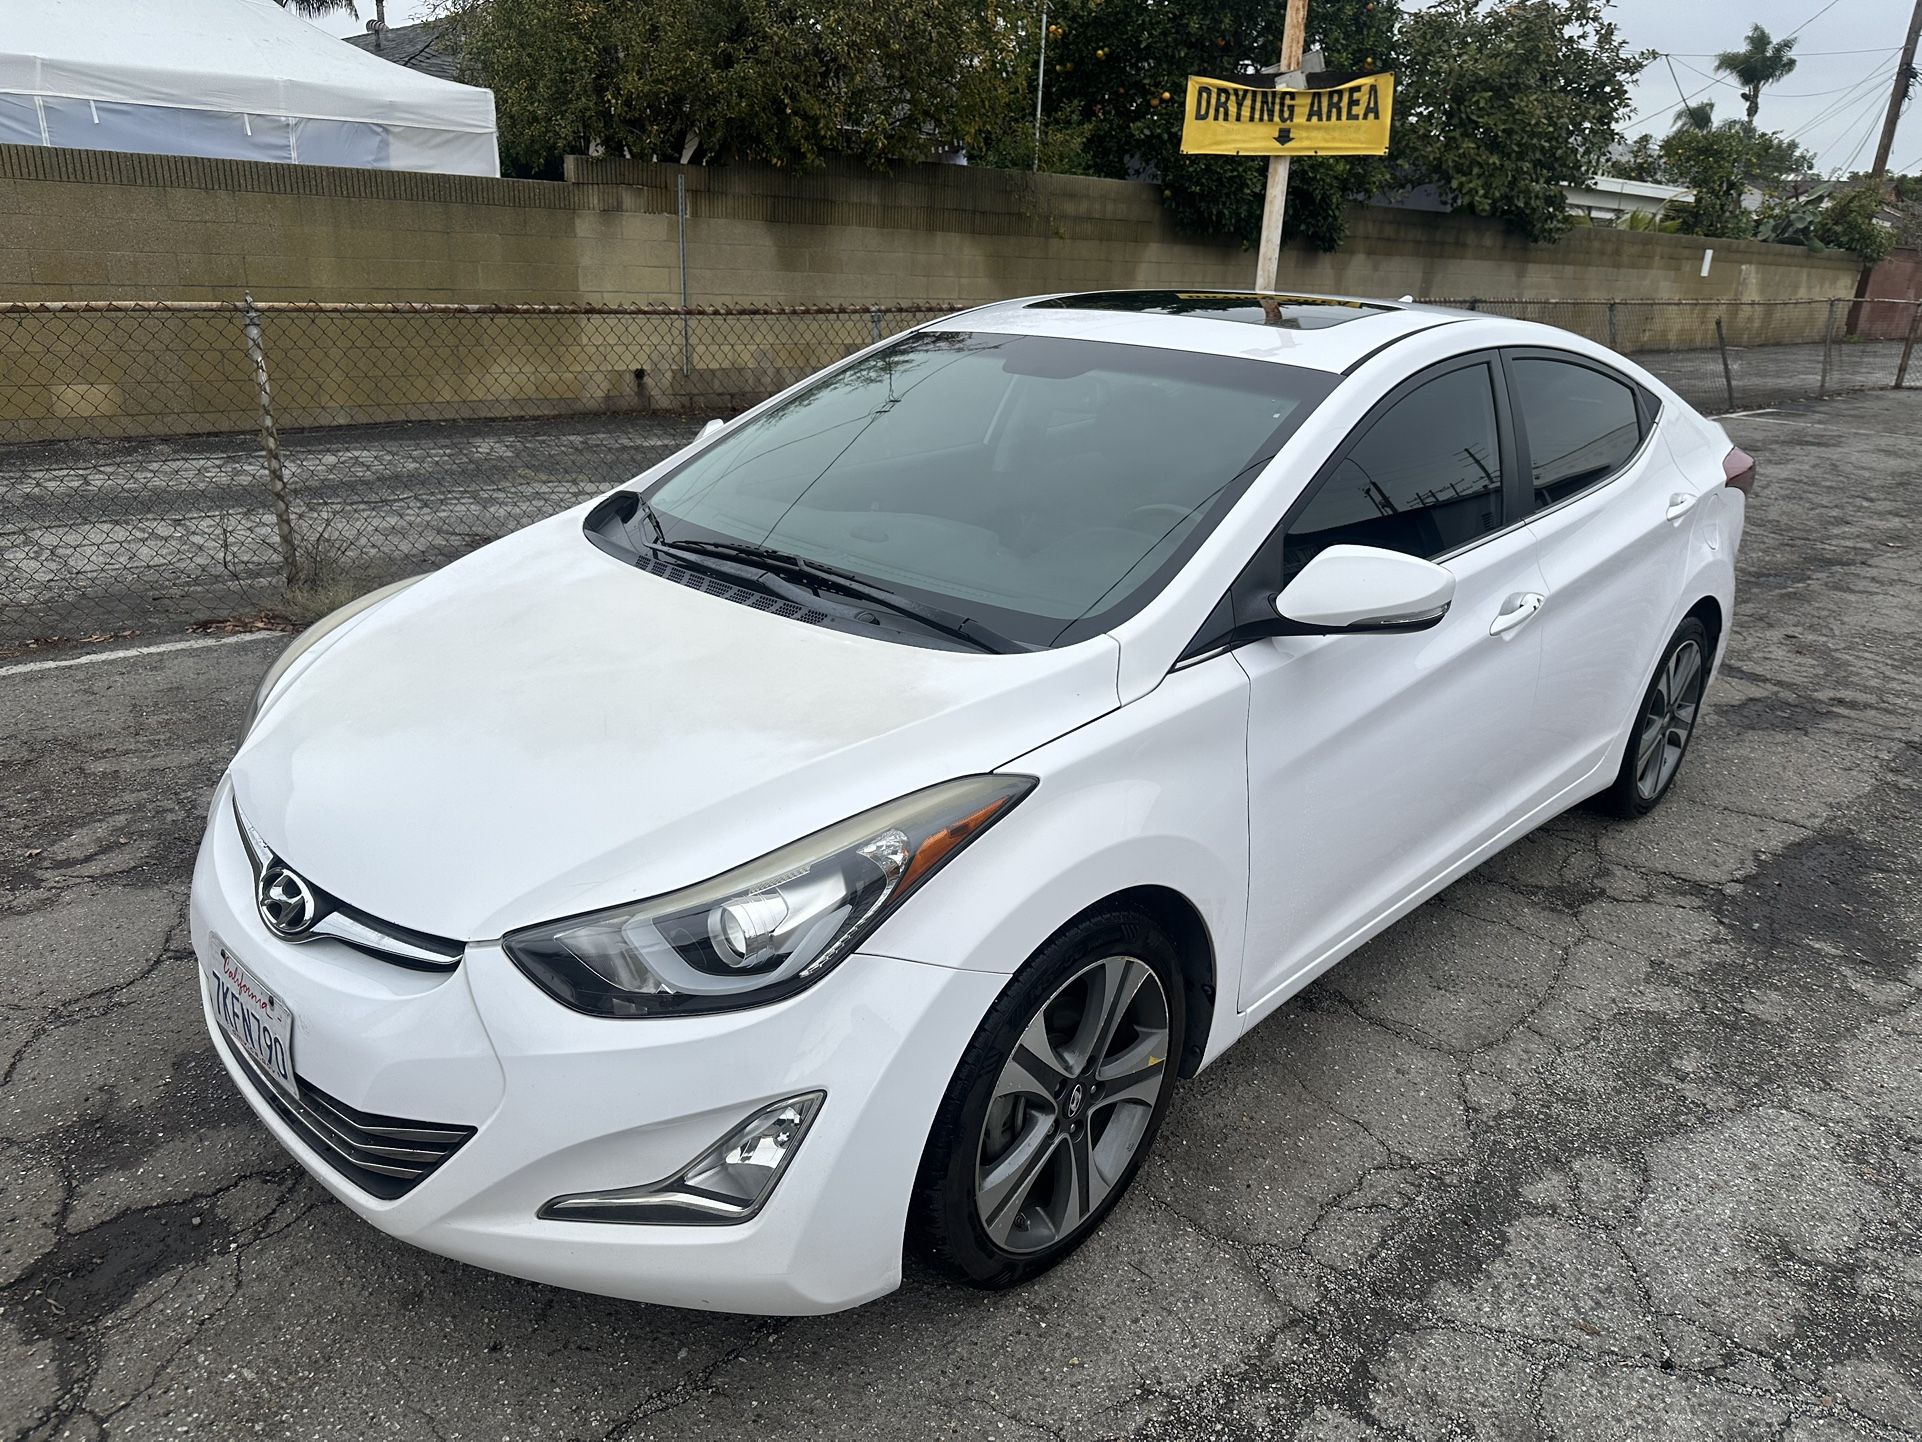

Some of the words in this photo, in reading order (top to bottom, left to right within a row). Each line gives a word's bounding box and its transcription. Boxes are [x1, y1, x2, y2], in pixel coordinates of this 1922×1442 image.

[1195, 86, 1295, 123] DRYING
[1305, 84, 1380, 121] AREA
[223, 956, 273, 1019] California
[212, 970, 288, 1080] 7KFN790
